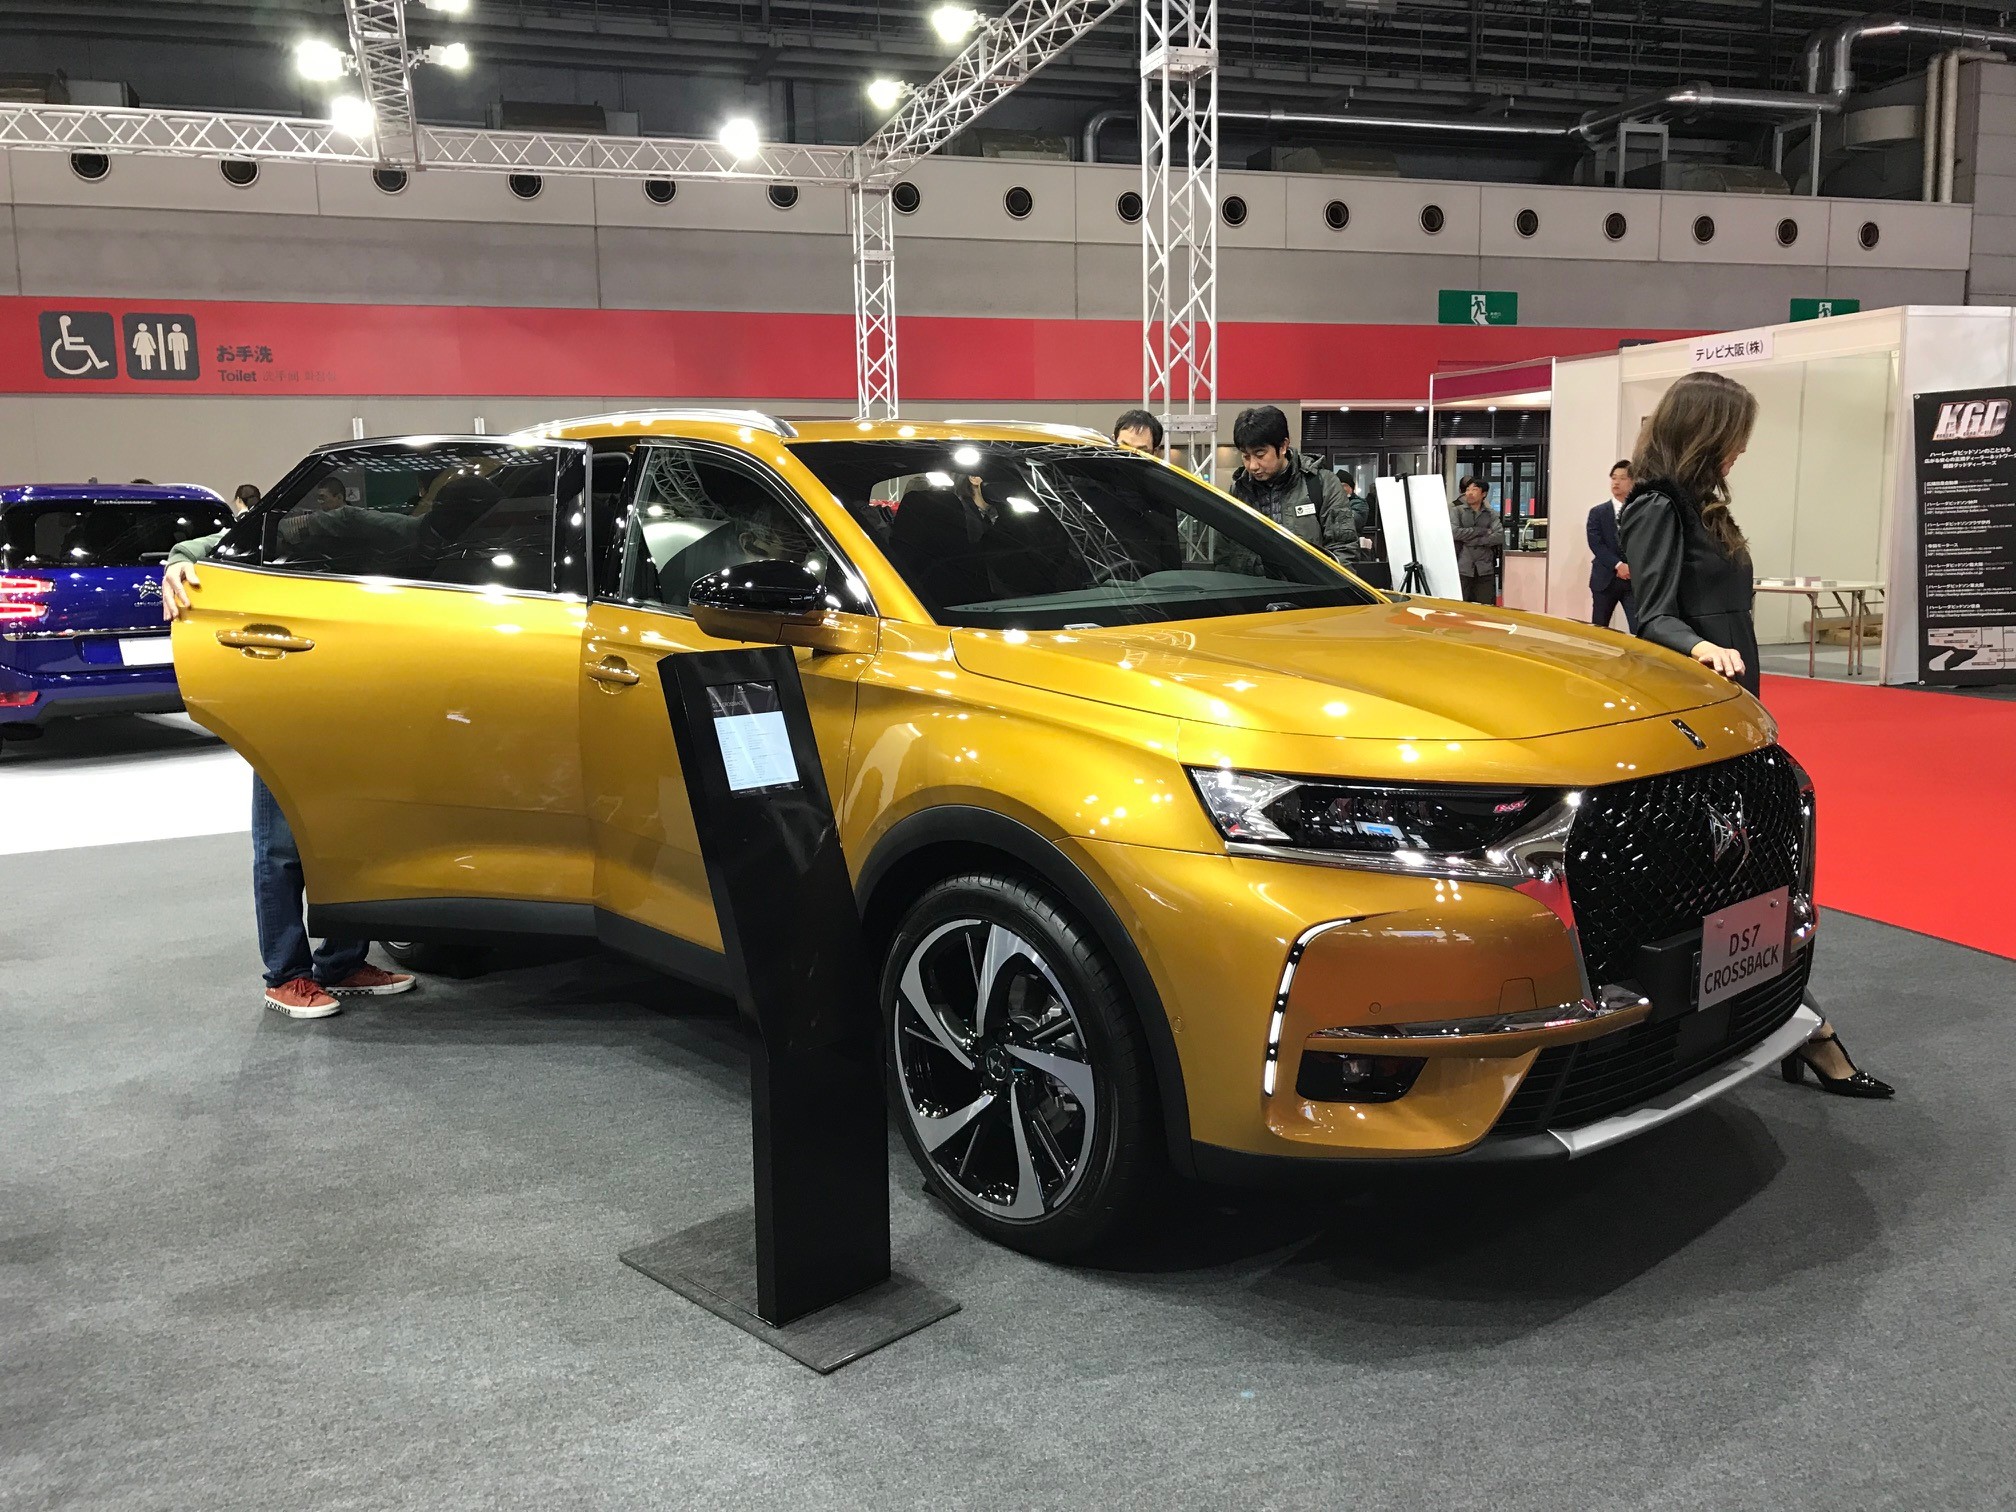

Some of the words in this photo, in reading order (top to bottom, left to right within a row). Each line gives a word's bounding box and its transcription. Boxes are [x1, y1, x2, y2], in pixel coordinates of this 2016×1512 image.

[217, 345, 273, 363] お手洗
[217, 370, 257, 382] Toilet
[1729, 923, 1760, 957] DS7
[1704, 944, 1779, 995] CROSSBACK
